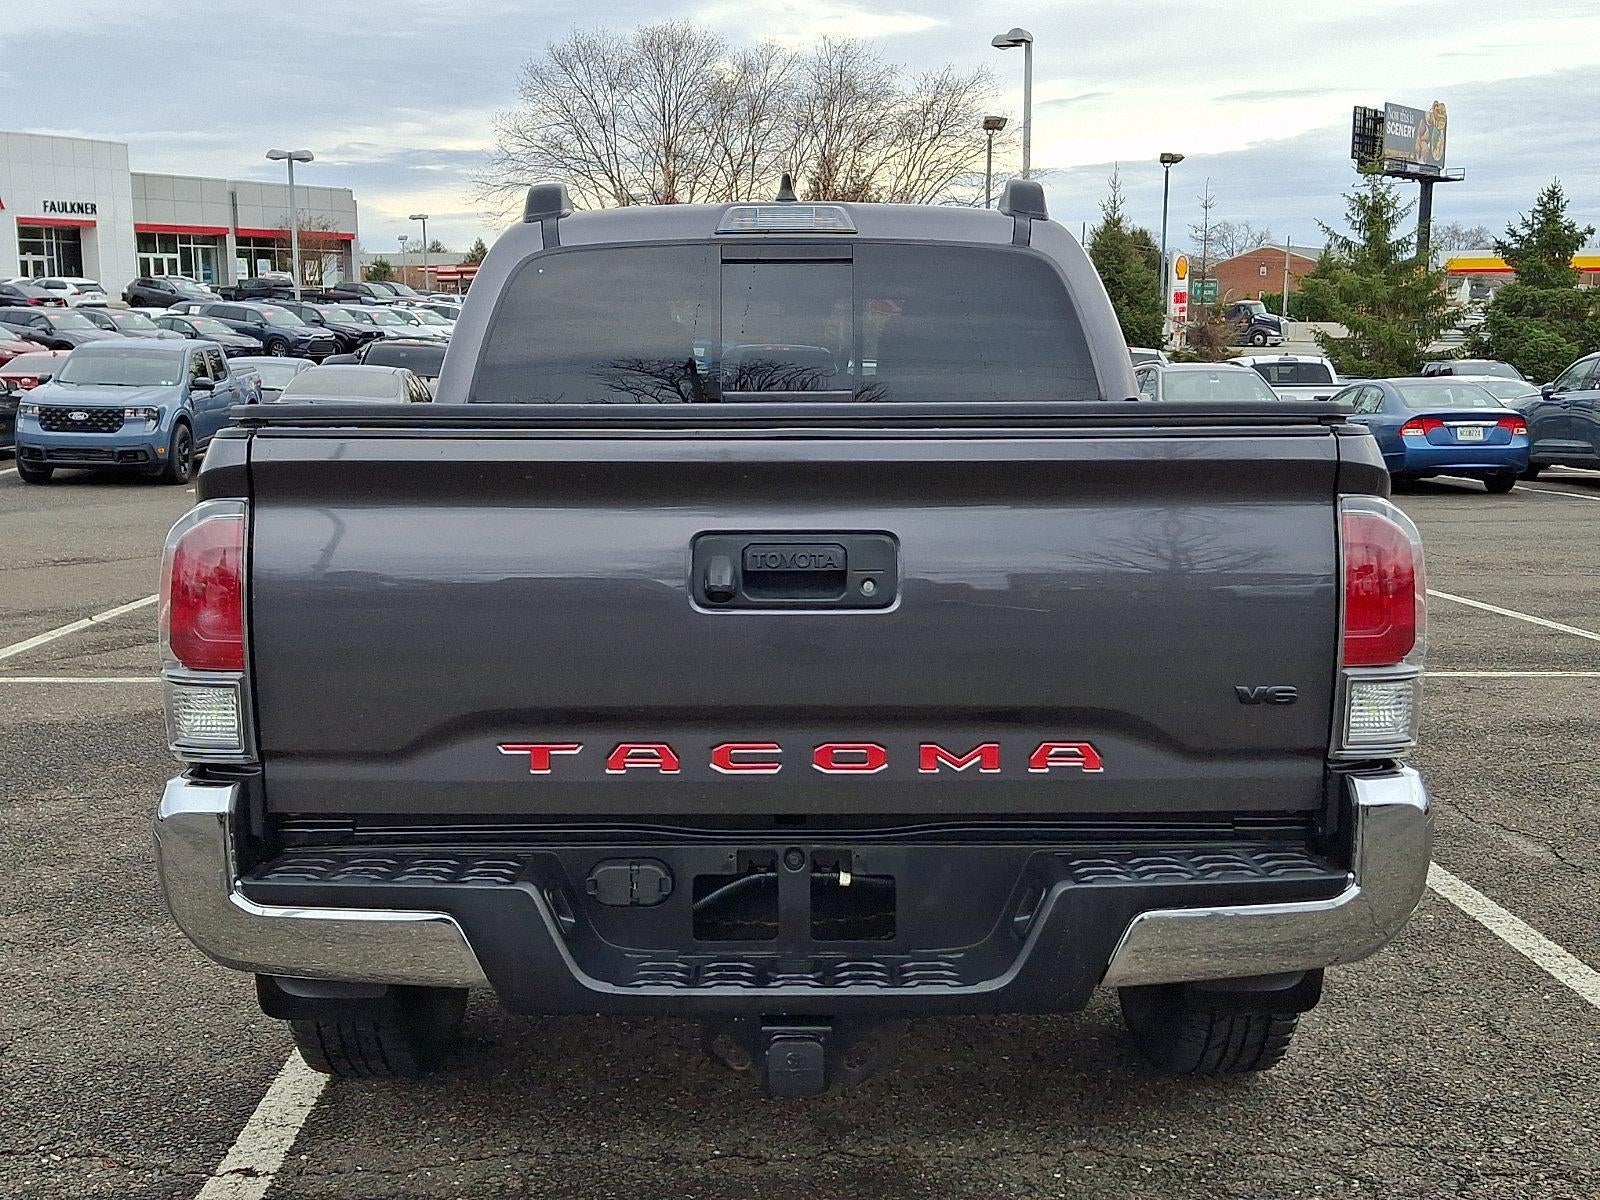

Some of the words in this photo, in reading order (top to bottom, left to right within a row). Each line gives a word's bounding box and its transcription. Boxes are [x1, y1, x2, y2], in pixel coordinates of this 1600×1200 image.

[1386, 120, 1416, 138] SCENERY
[43, 200, 97, 214] FAULKNER
[752, 554, 838, 569] TOYOTA
[1234, 685, 1298, 705] V6
[497, 743, 1103, 774] TACOMA
